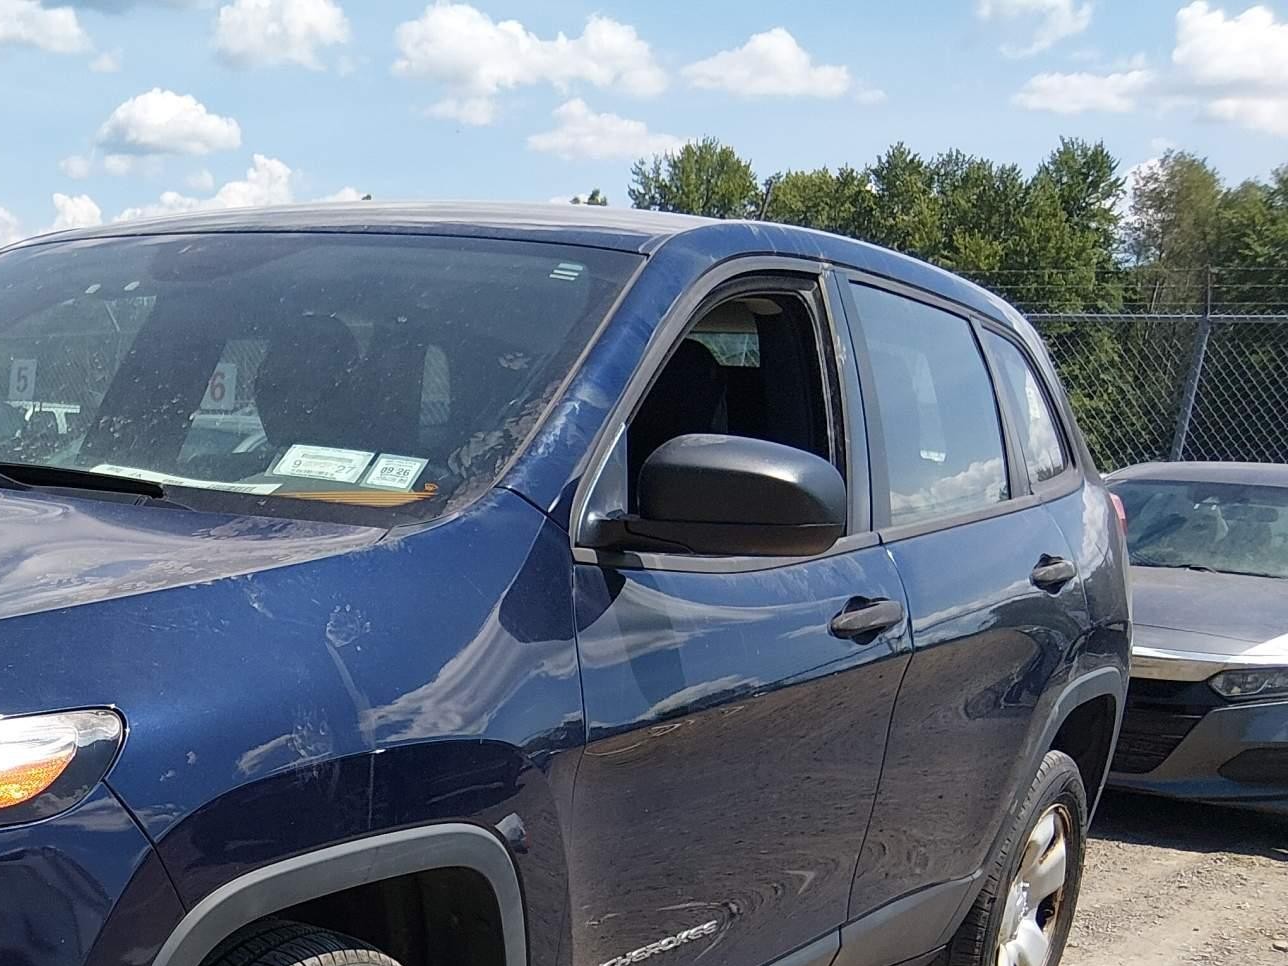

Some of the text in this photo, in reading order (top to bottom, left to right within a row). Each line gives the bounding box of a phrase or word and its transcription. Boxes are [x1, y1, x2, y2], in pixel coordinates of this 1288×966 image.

[15, 366, 30, 393] 5
[210, 371, 227, 401] 6
[380, 466, 410, 477] 09 26
